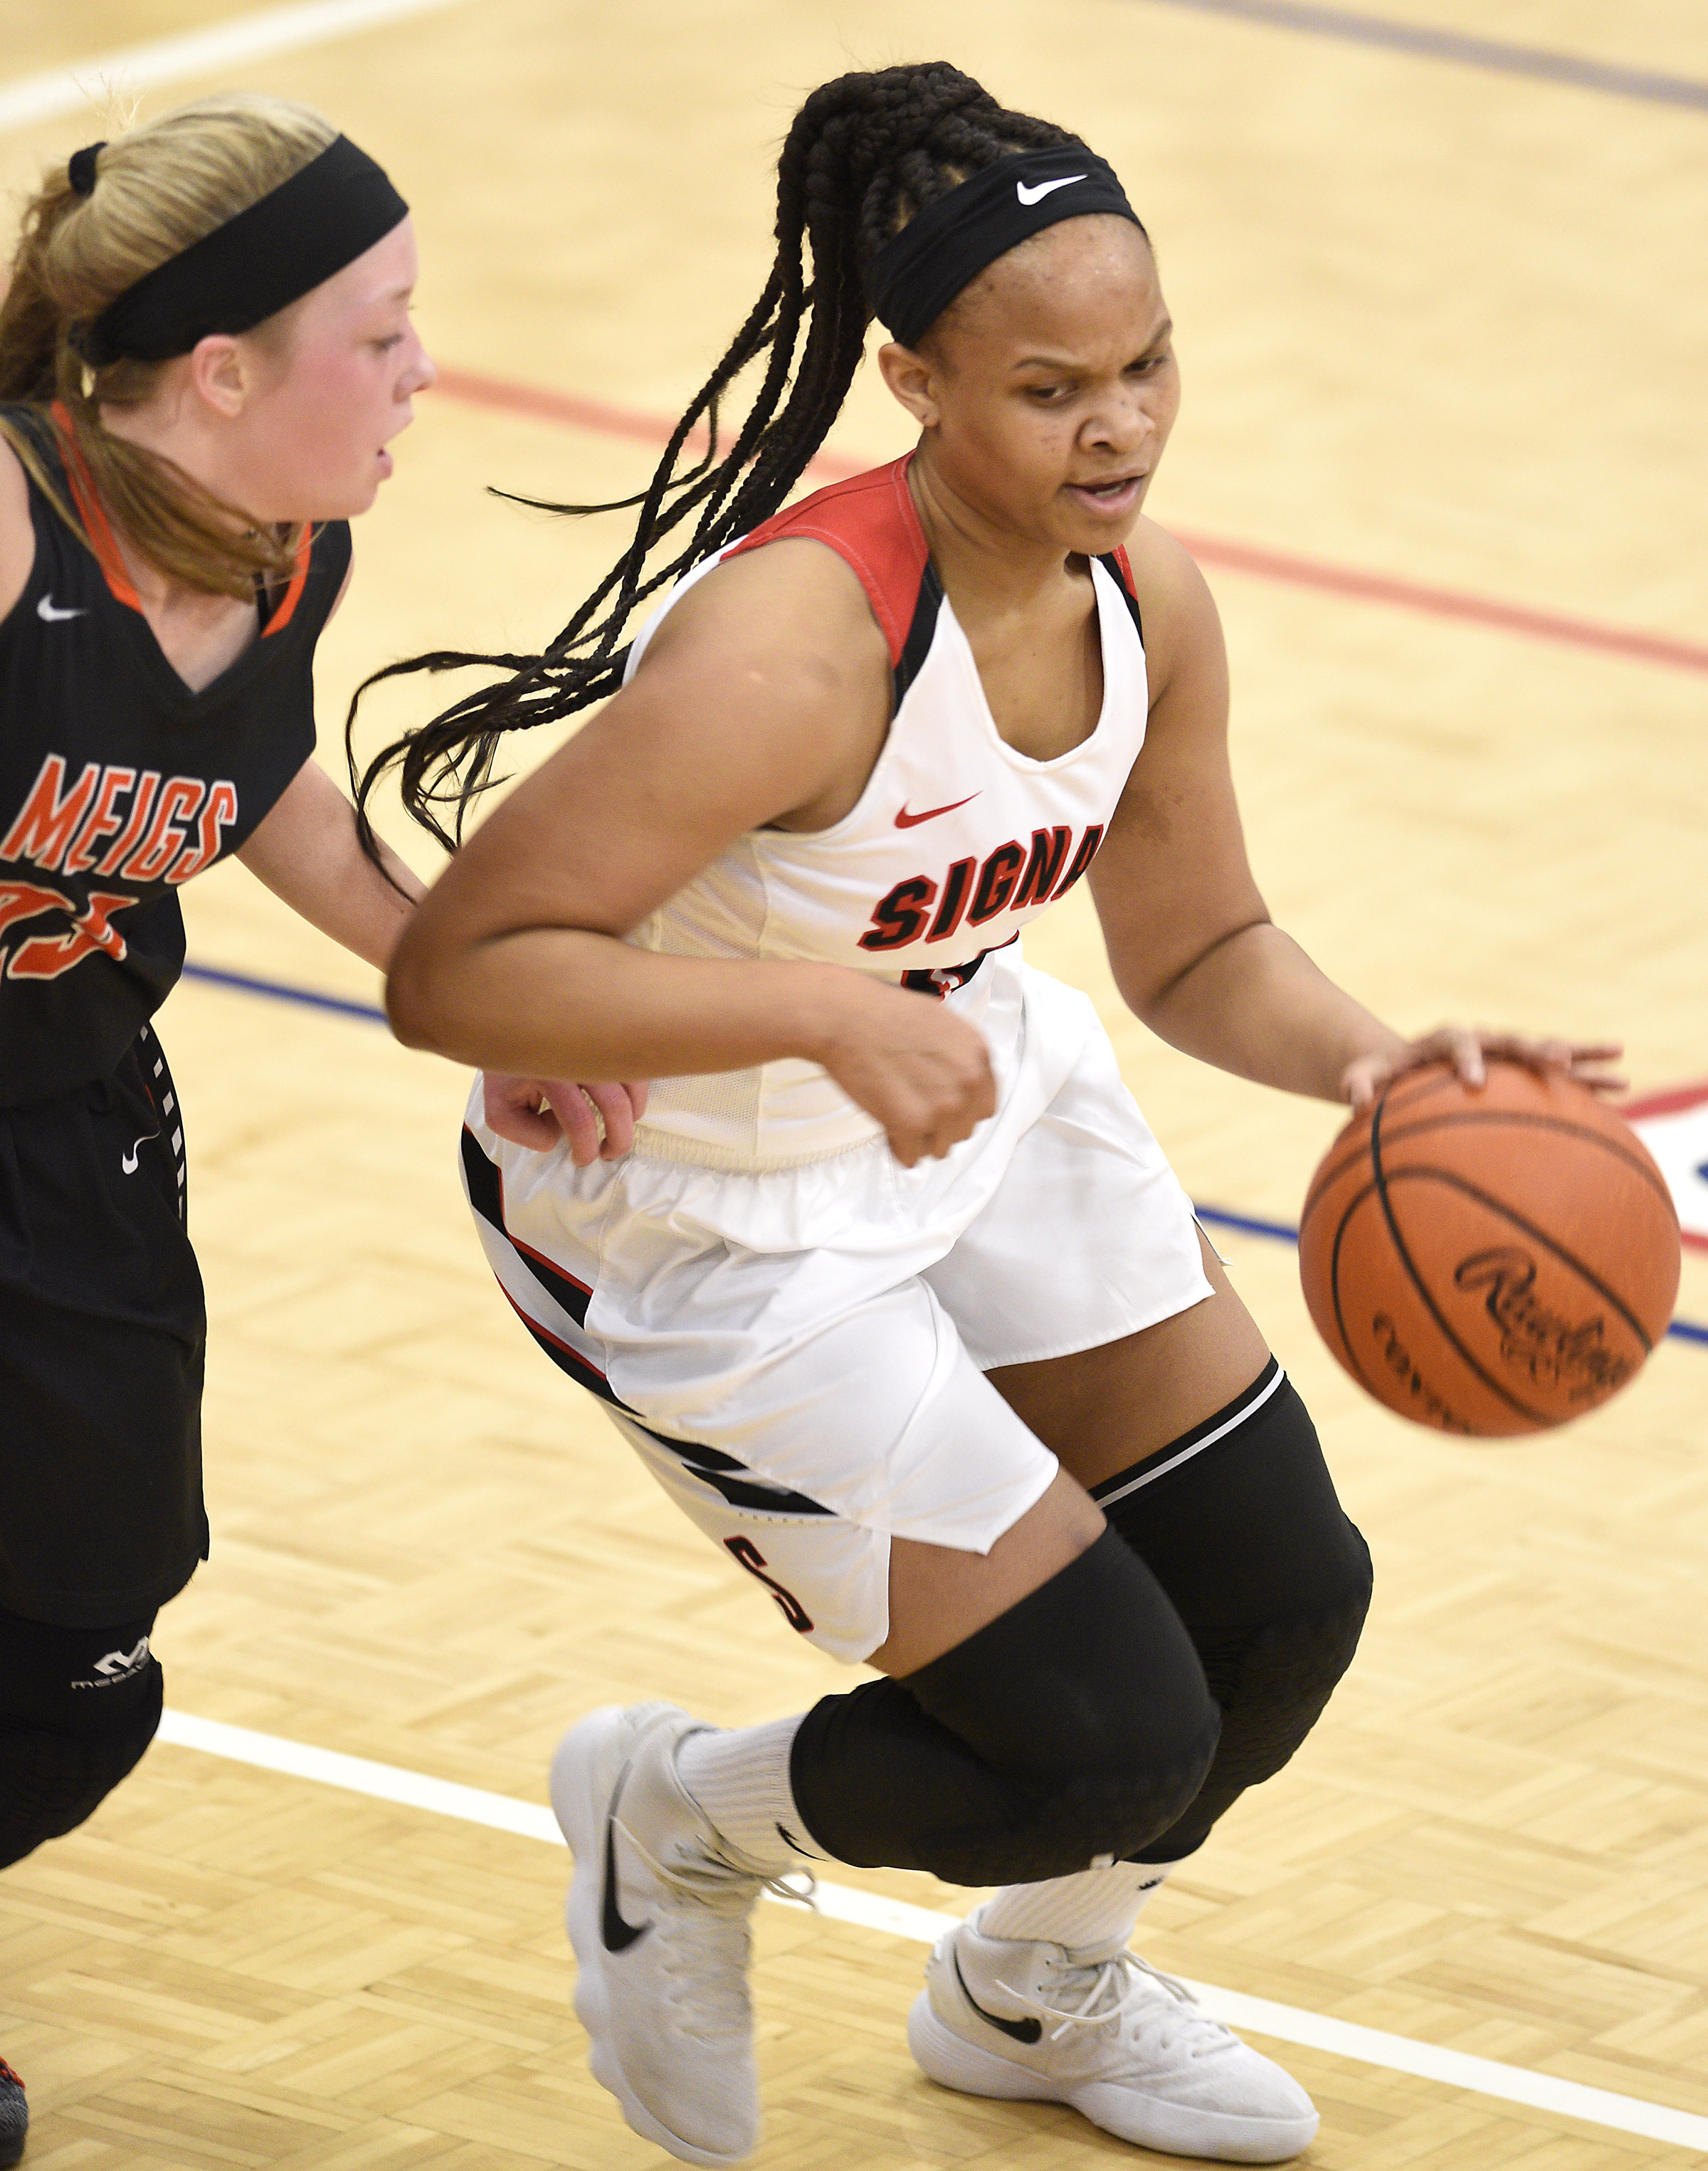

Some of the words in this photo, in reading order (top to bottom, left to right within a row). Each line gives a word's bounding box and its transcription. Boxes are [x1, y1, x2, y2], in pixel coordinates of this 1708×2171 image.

[0, 752, 238, 885] MEIGS
[856, 824, 1104, 952] SIGNA
[723, 1534, 815, 1634] S
